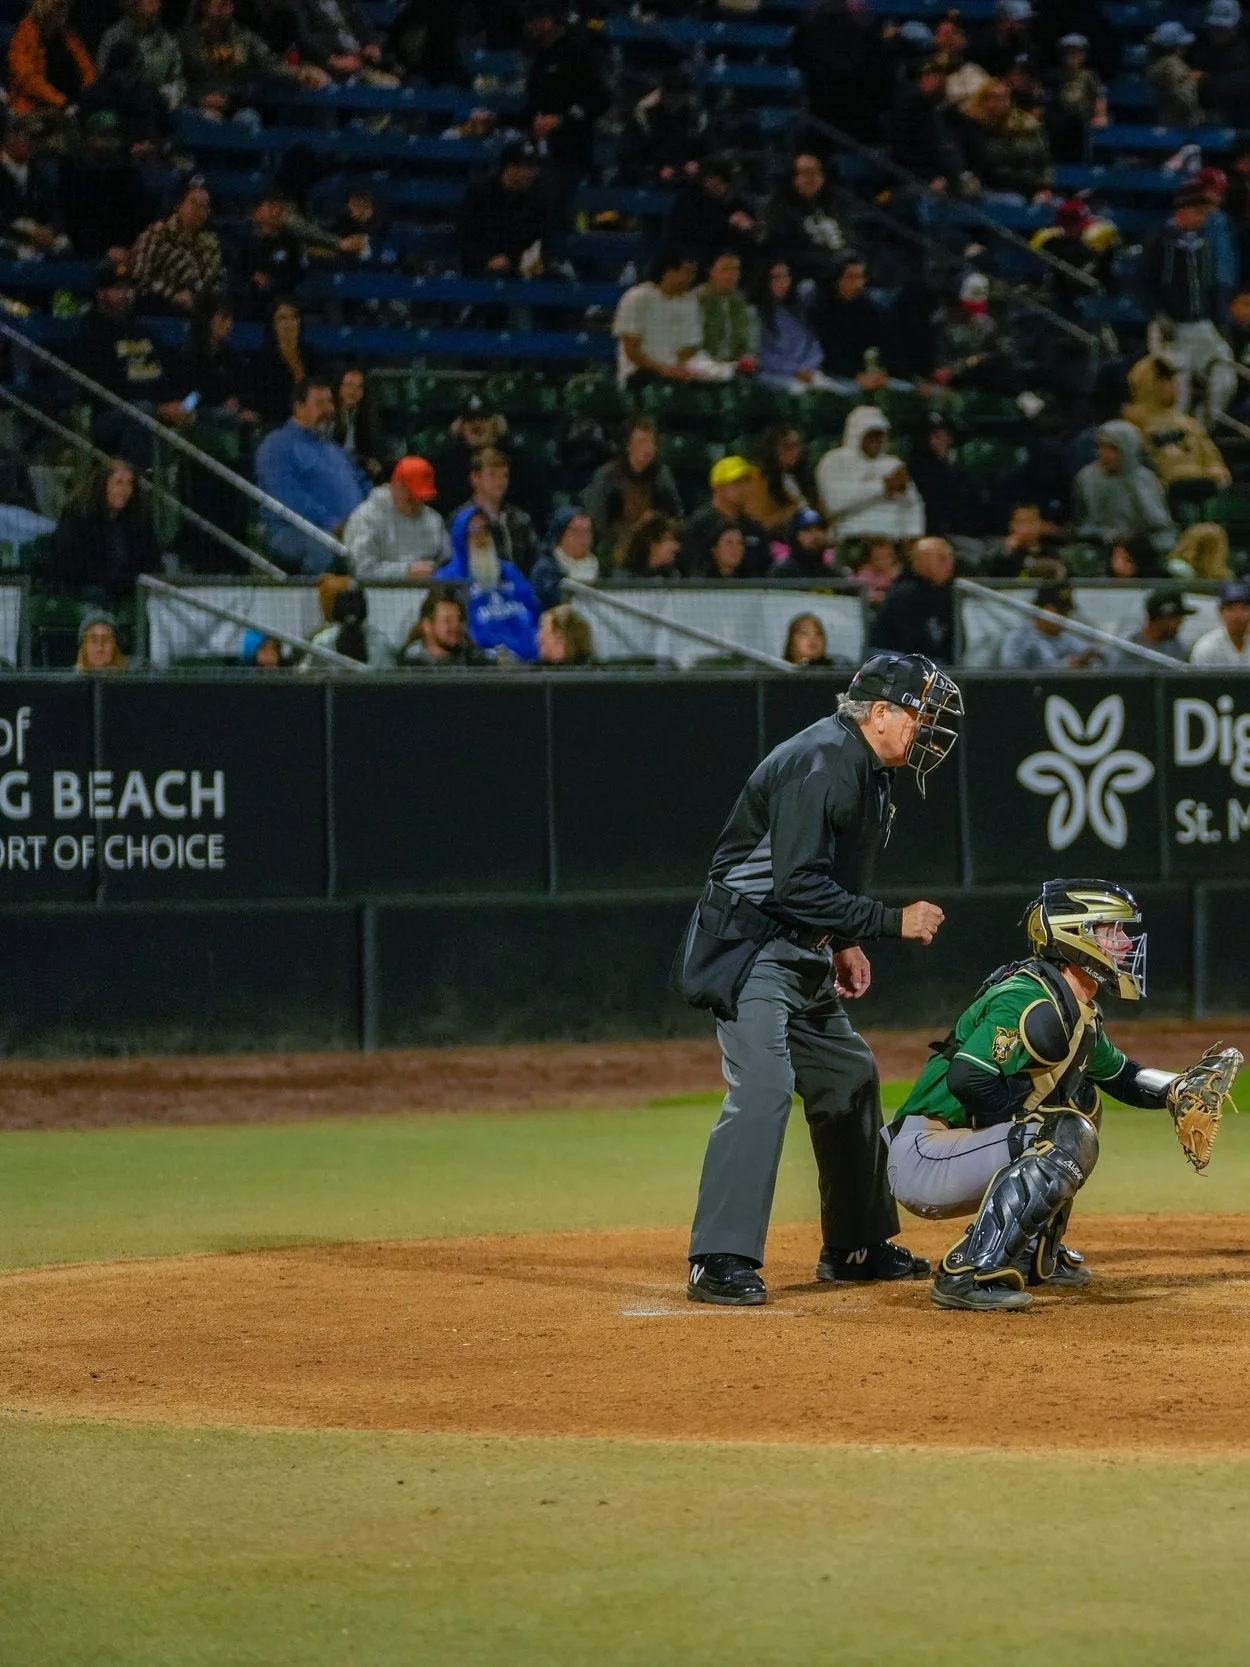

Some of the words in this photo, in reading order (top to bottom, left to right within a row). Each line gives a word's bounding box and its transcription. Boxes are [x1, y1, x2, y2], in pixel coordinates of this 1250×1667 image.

[53, 770, 226, 819] BEACH
[1175, 798, 1222, 843] St.
[0, 835, 48, 870] RT
[53, 834, 95, 870] OF
[104, 834, 227, 871] CHOICE
